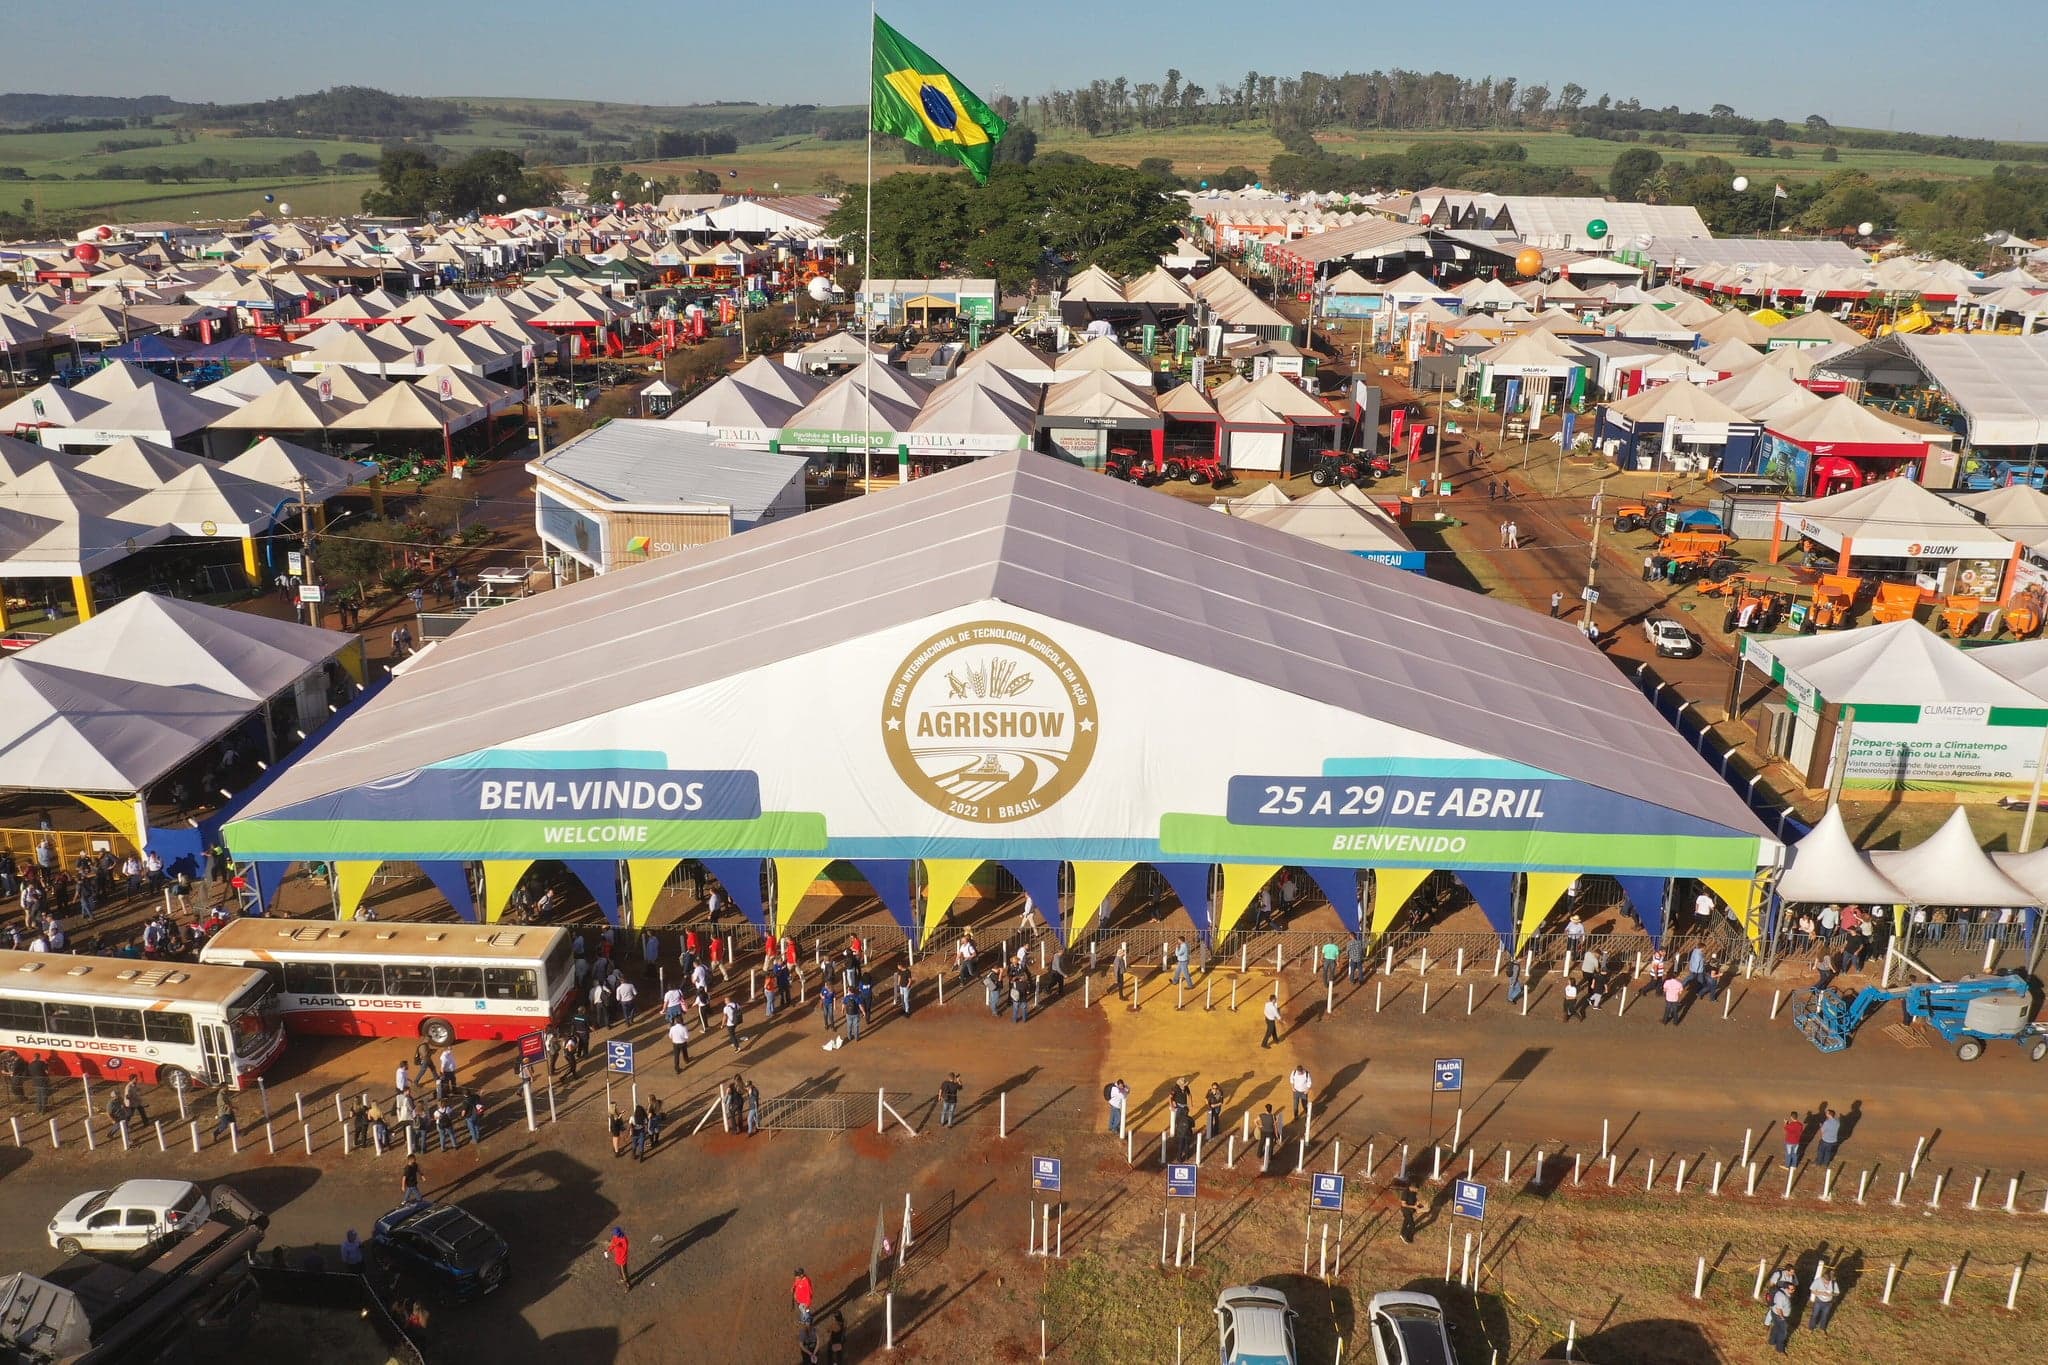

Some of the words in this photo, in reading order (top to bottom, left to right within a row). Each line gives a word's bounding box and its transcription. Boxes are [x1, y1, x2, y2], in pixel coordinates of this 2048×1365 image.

[719, 429, 760, 441] ITALIA
[832, 432, 884, 445] Italiano
[910, 435, 953, 447] ITALIA
[1805, 523, 1821, 536] BUDNY
[1922, 545, 1958, 556] BUDNY
[891, 684, 907, 708] FEIRA
[904, 635, 958, 683] INTERNACIONAL
[959, 631, 972, 642] DE
[973, 628, 1027, 644] TECNOLOGIA
[1028, 637, 1066, 669] AGRÍCOLA
[1062, 668, 1076, 683] EM
[1071, 681, 1088, 707] AÇÃO
[1924, 705, 1985, 716] CLIMATEMPO
[917, 711, 1065, 738] AGRISHOW
[1852, 738, 1907, 749] Prepare-se
[1910, 741, 1932, 749] com
[1944, 741, 2008, 752] Climatempo
[1850, 749, 1873, 758] para
[1885, 749, 1894, 757] El
[1939, 751, 1951, 759] La
[1954, 750, 1980, 759] Niña.
[1952, 770, 1992, 778] Agroclima
[479, 781, 704, 811] BEM-VINDOS
[1259, 786, 1307, 815] 25
[1310, 789, 1332, 815] A
[1339, 786, 1385, 815] 29
[1391, 790, 1435, 817] DE
[1437, 788, 1545, 818] ABRIL
[949, 800, 979, 818] 2022
[999, 798, 1041, 818] BRASIL
[543, 826, 649, 844] WELCOME
[1332, 834, 1467, 854] BIENVENIDO
[299, 996, 356, 1008] RÁPIDO
[358, 999, 423, 1009] D'OESTE
[16, 1034, 72, 1048] RÁPIDO
[75, 1040, 138, 1053] D'OESTE
[1437, 1061, 1460, 1071] SAÍDA
